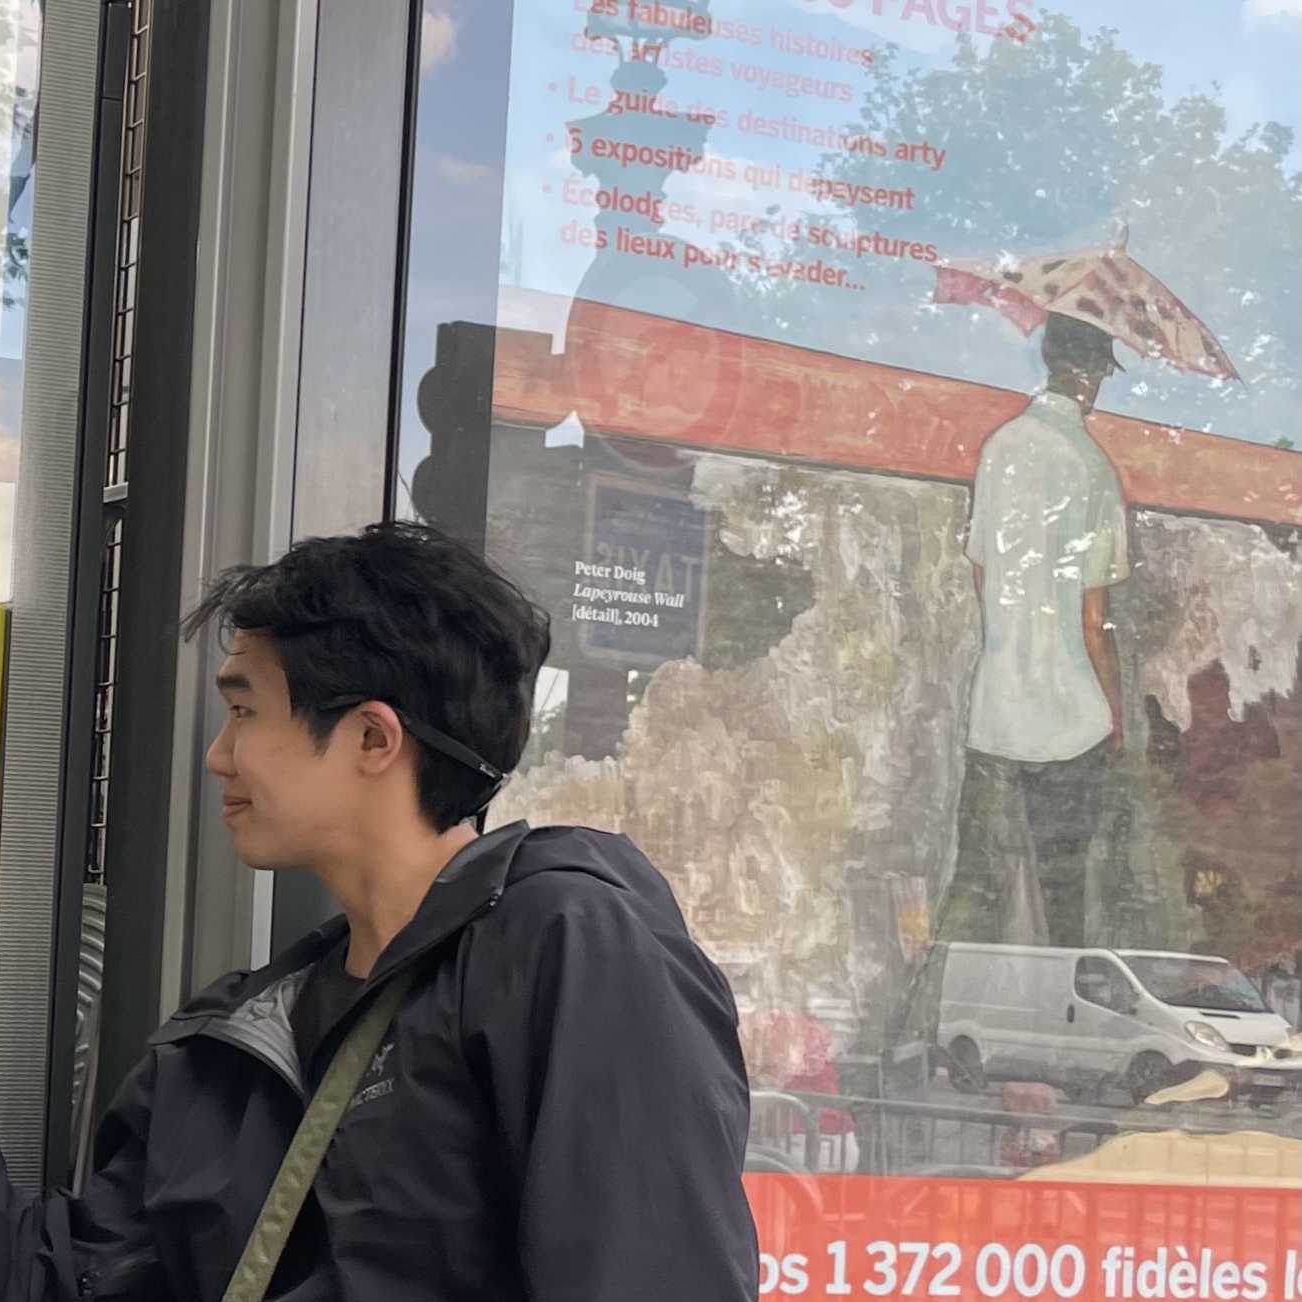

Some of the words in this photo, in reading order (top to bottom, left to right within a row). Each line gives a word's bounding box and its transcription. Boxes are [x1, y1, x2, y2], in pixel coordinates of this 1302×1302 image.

[770, 25, 875, 69] histoires
[730, 61, 854, 101] voyageurs
[567, 75, 600, 105] Le
[607, 88, 679, 119] guide
[685, 98, 730, 129] des
[736, 110, 887, 158] destinations
[894, 139, 947, 172] arty
[590, 136, 737, 180] expositions
[742, 164, 780, 190] qui
[560, 219, 609, 250] des
[616, 226, 676, 261] lieux
[771, 215, 801, 244] de
[574, 560, 610, 579] Peter
[613, 565, 646, 585] Doig
[572, 583, 652, 606] Lapeyrouse
[653, 591, 686, 609] Wall
[624, 610, 660, 628] 2004
[758, 1252, 810, 1295] os
[862, 1240, 963, 1296] 372
[975, 1242, 1086, 1299] 000
[1101, 1245, 1268, 1300] fidèles
[1283, 1249, 1302, 1300] l
